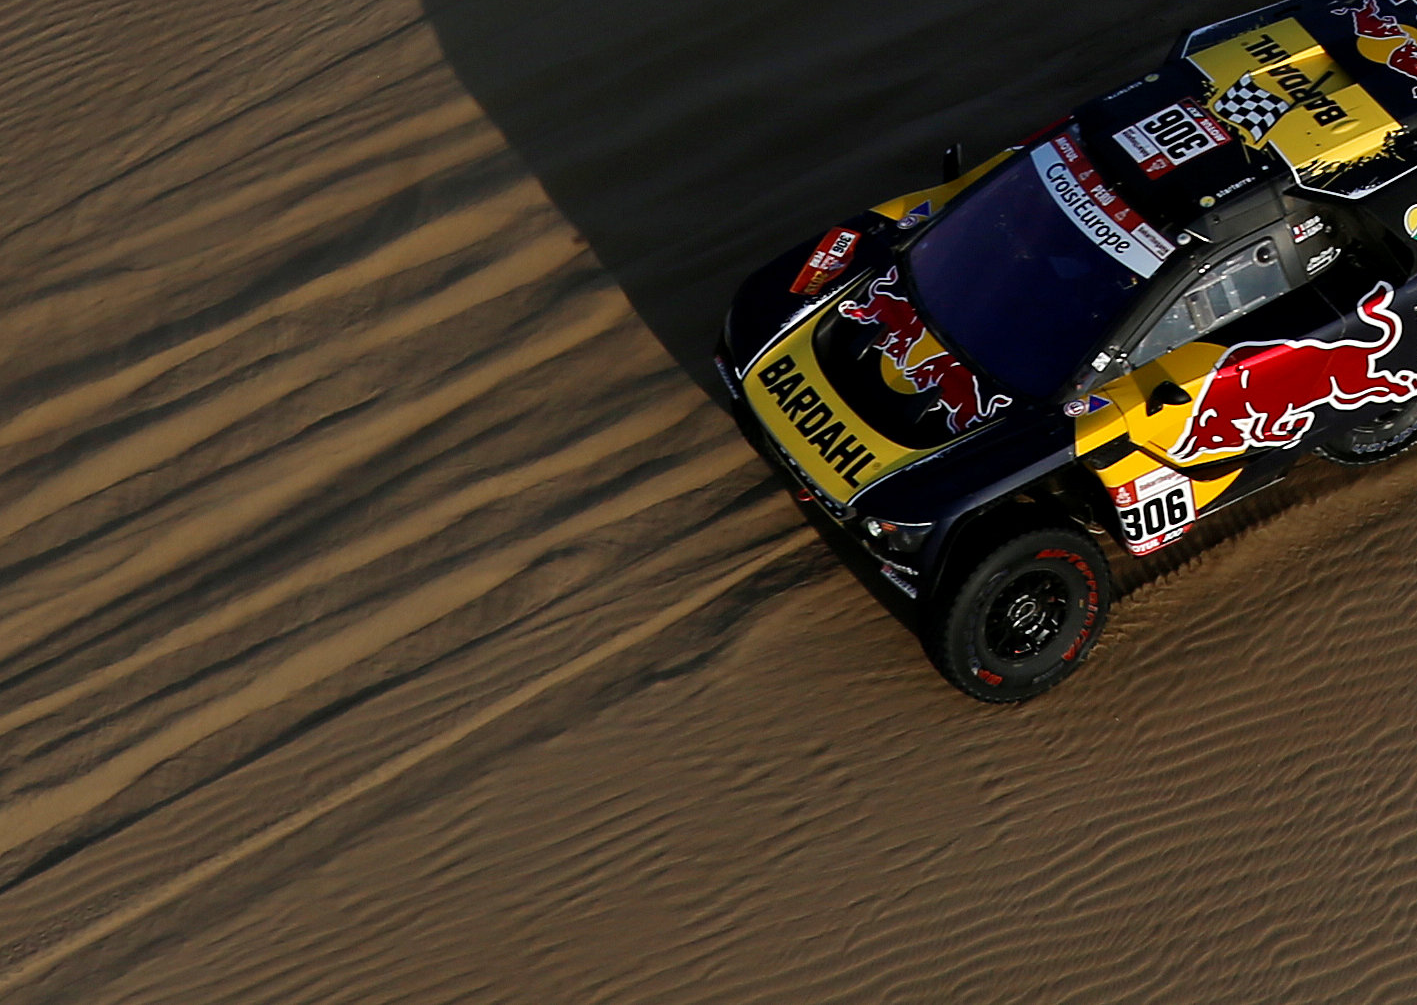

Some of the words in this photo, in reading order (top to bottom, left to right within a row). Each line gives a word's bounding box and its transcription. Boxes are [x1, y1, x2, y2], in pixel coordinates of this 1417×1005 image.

[1244, 33, 1349, 128] BARDAHL
[1054, 136, 1079, 163] MOTUL
[1142, 108, 1210, 160] 306
[1199, 118, 1227, 142] MOTUL
[1046, 162, 1131, 254] CroisiEurope
[831, 234, 853, 255] 306
[757, 353, 877, 489] BARDAHL
[1119, 488, 1188, 542] 306
